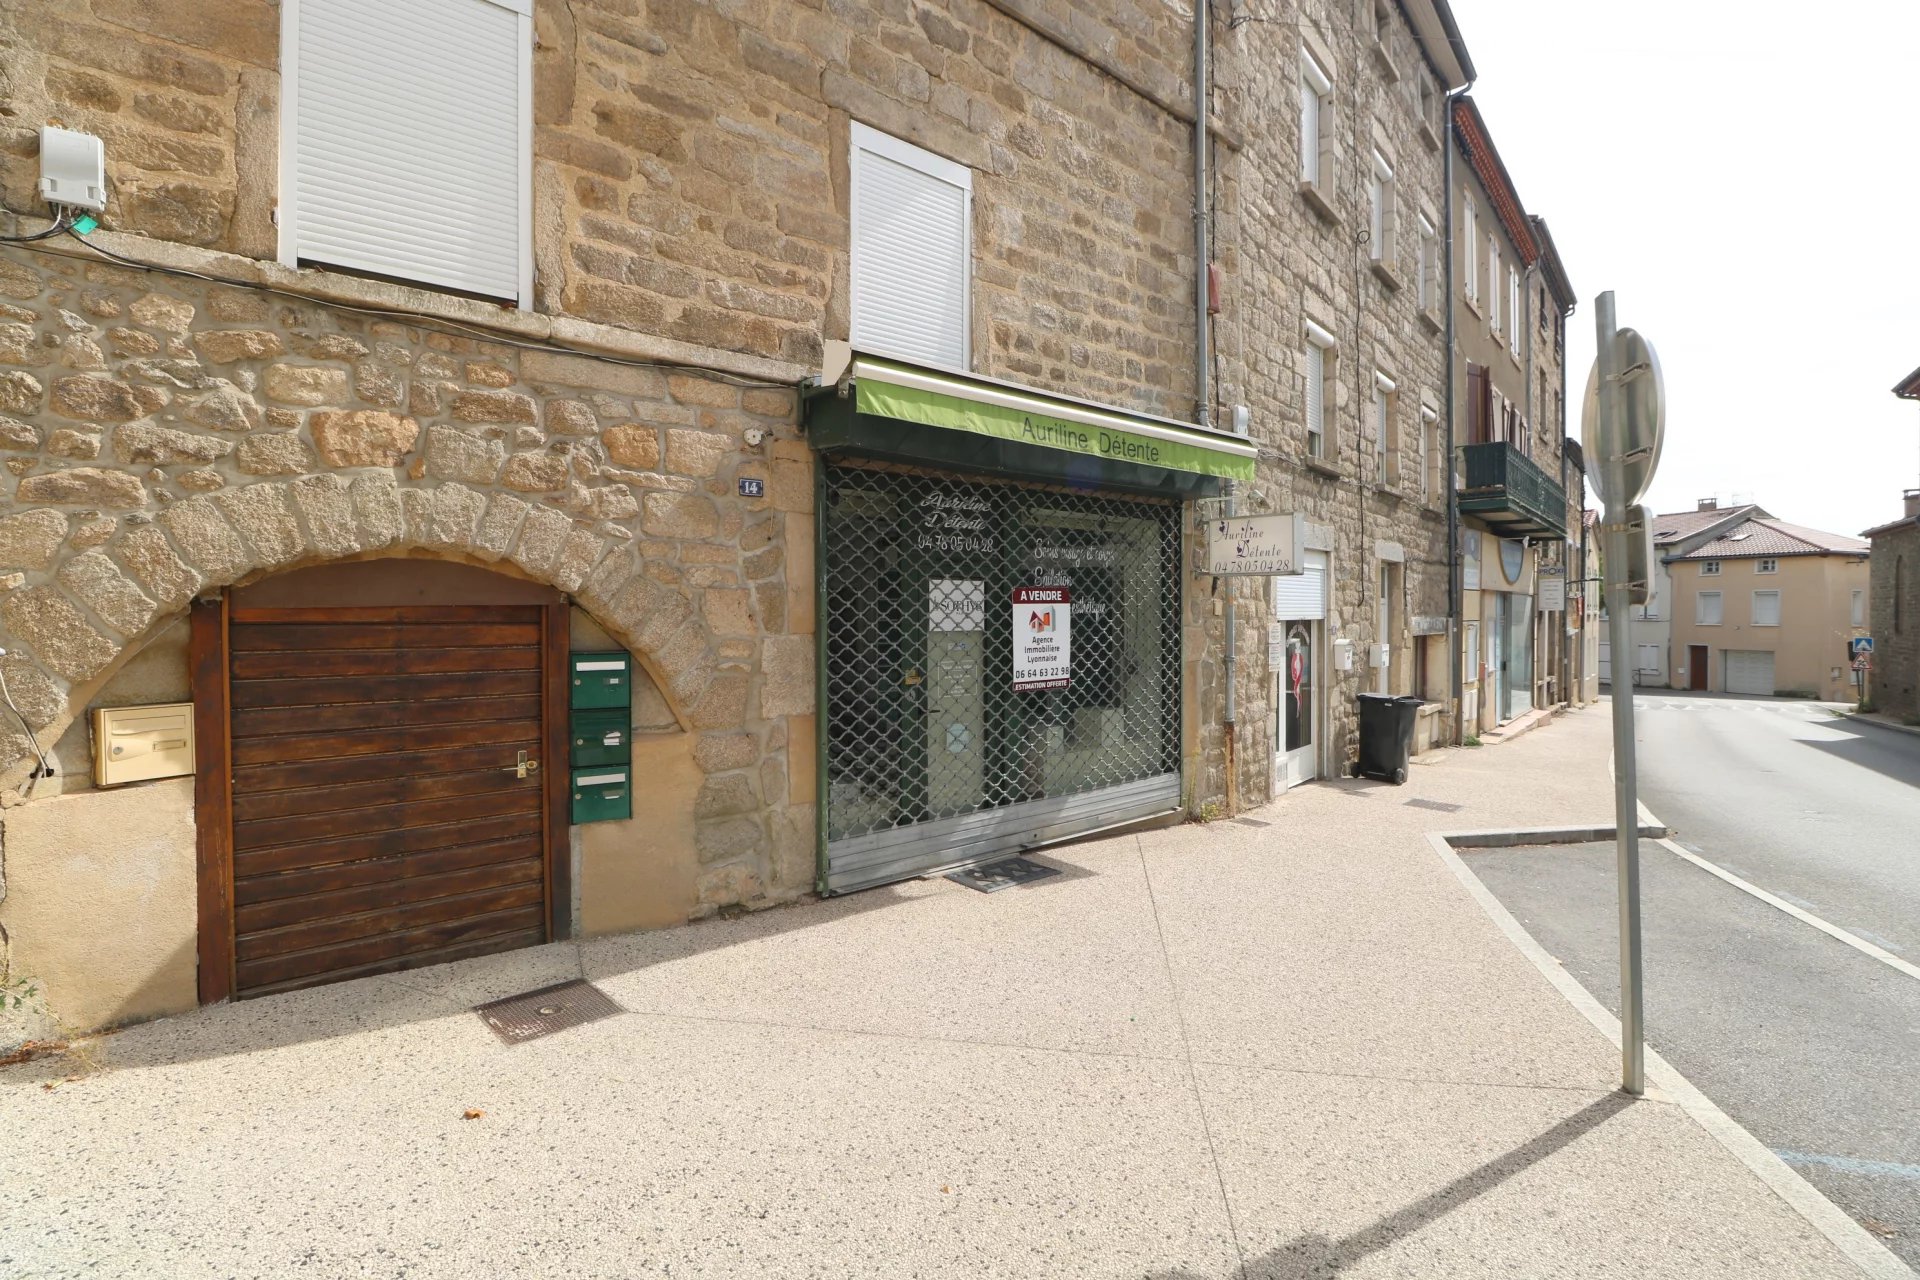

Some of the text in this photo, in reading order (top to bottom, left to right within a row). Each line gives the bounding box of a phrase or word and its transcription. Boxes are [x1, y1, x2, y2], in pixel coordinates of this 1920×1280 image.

[1022, 416, 1159, 462] Auriline Détente
[744, 481, 758, 494] 14
[920, 491, 991, 511] Auriline
[1213, 520, 1264, 543] Auriline
[1236, 539, 1281, 558] Détente
[1020, 591, 1062, 600] A VENDRE
[1032, 636, 1053, 645] Agence
[1027, 655, 1057, 664] Lyonnaise
[1015, 666, 1069, 678] 06 64 63 22 98
